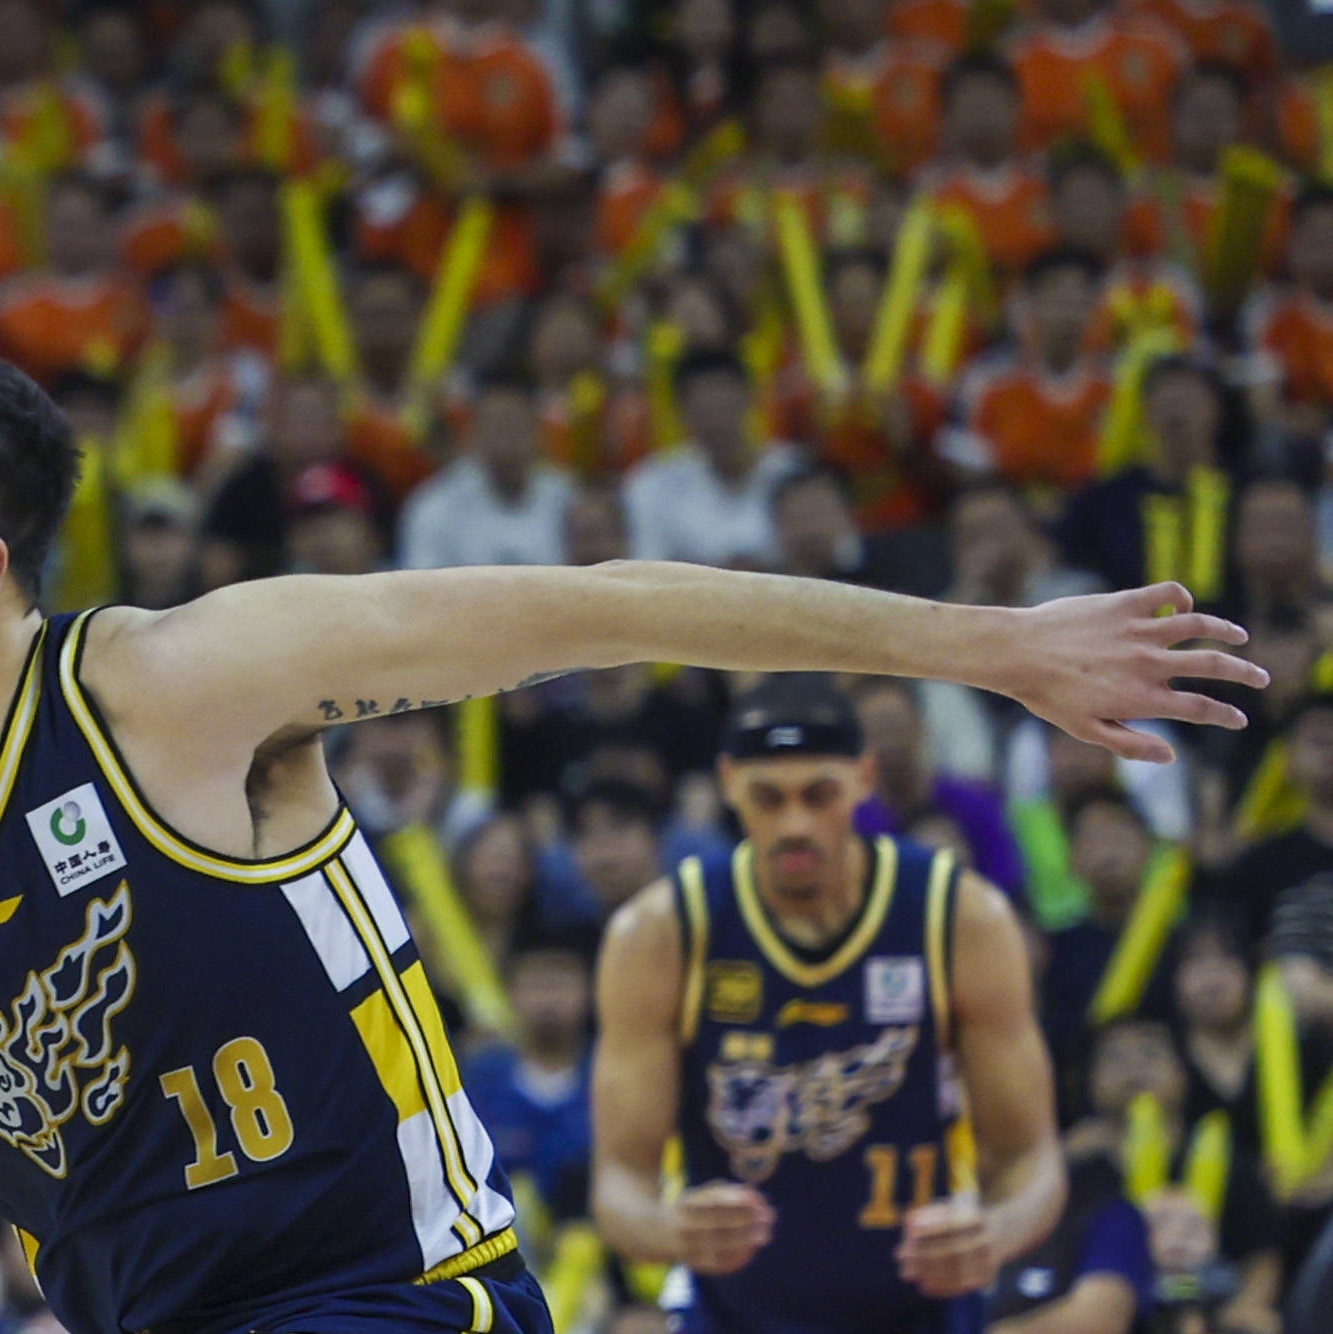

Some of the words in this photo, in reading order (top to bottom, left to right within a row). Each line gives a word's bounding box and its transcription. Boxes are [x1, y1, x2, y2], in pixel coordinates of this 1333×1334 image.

[60, 866, 92, 885] CHINA
[93, 854, 115, 869] LIFE
[158, 1036, 294, 1190] 18
[860, 1143, 937, 1228] 11
